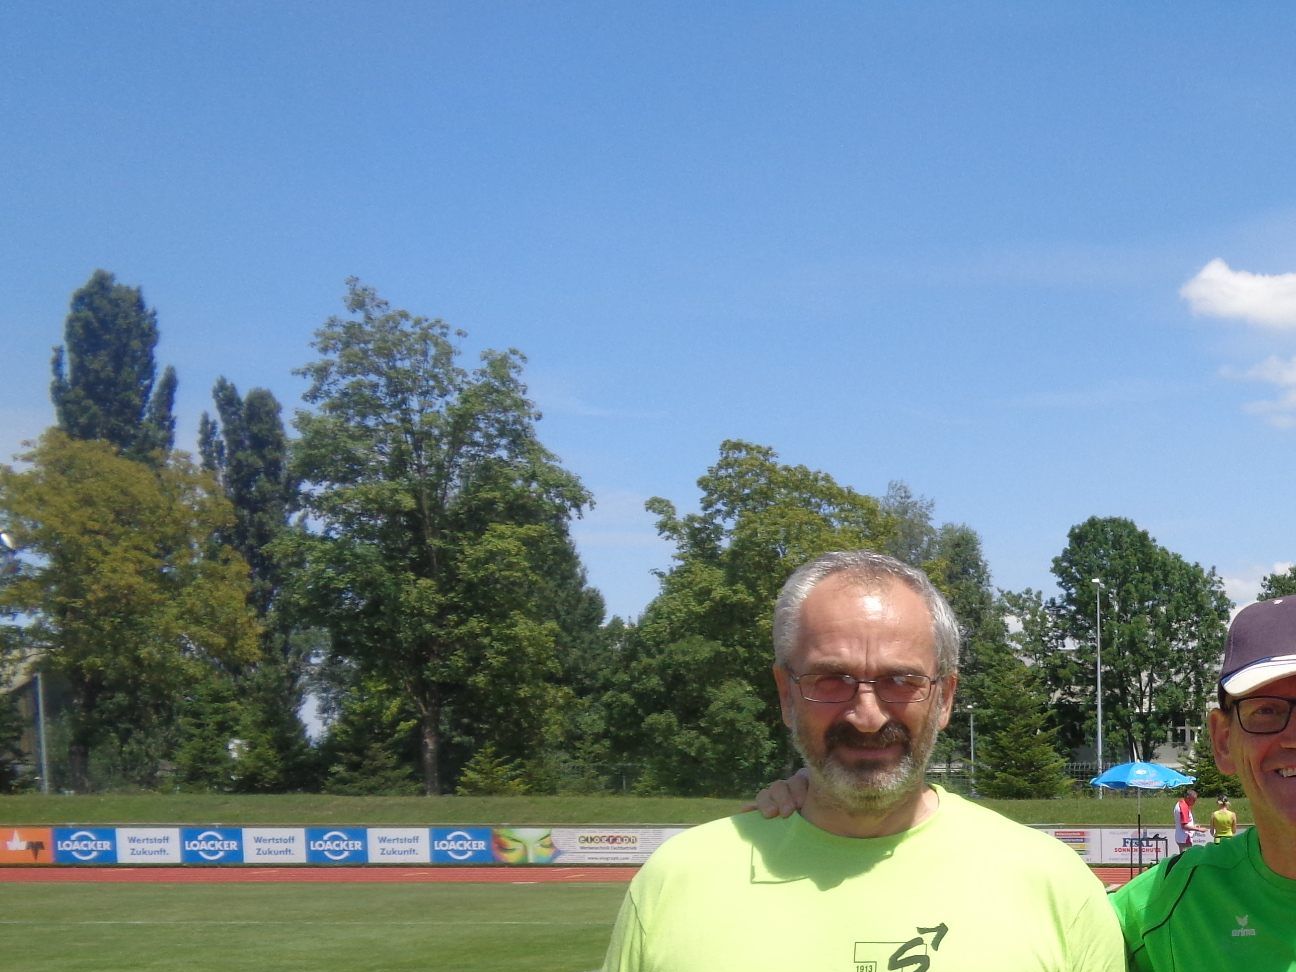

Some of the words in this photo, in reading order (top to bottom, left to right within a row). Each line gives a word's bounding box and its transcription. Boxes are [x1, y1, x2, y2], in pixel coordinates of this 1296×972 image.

[57, 839, 112, 851] LOACKER
[127, 835, 170, 845] Wertstoff
[253, 835, 295, 845] Wertstoff
[378, 835, 419, 845] Wertstoff
[185, 840, 238, 851] LOACKER
[310, 840, 362, 851] LOACKER
[434, 840, 486, 851] LOACKER
[129, 847, 170, 856] Zukunft.
[255, 847, 295, 856] Zukunft.
[380, 847, 419, 856] Zukunft.
